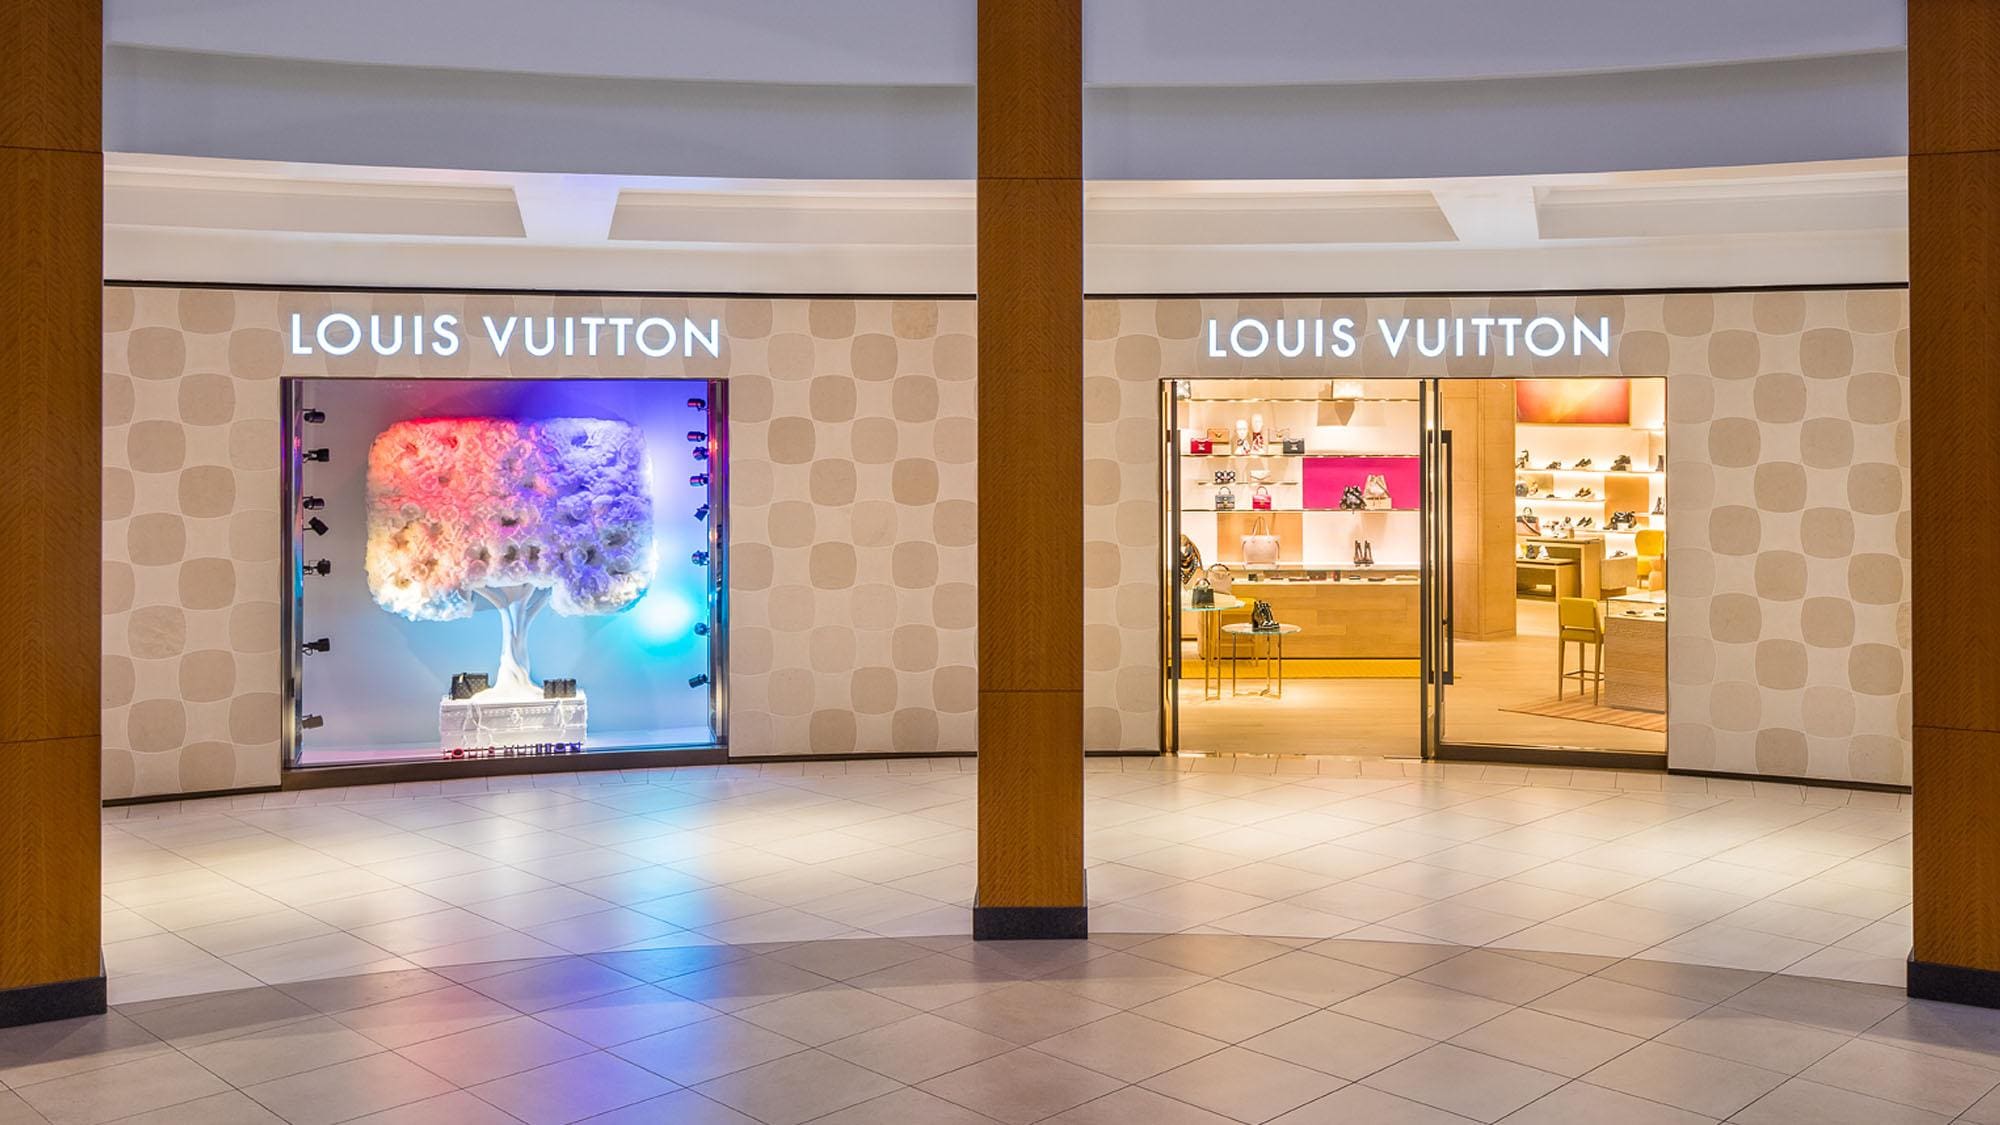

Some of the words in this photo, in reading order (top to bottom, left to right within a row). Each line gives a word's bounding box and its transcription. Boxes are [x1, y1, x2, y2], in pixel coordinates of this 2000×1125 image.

[292, 313, 459, 356] LOUIS
[482, 316, 719, 358] VUITTON
[1208, 318, 1356, 357] LOUIS
[1377, 316, 1610, 357] VUITTON
